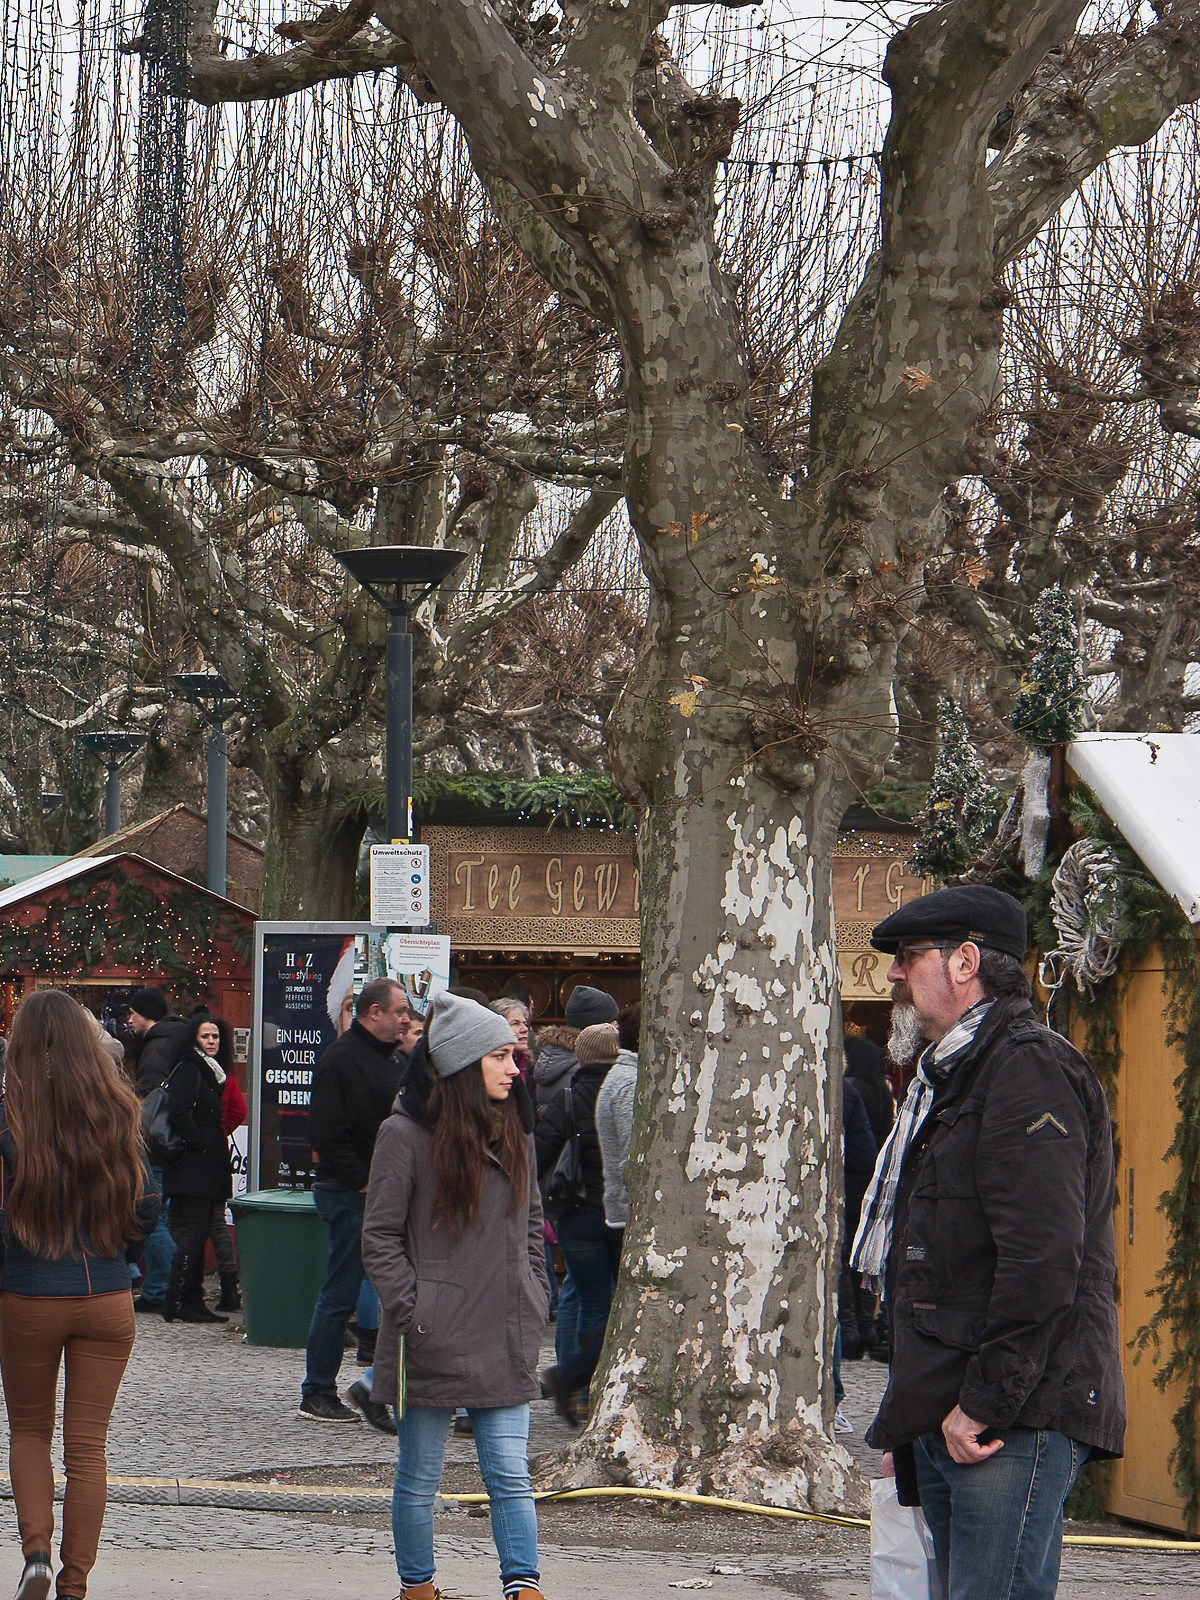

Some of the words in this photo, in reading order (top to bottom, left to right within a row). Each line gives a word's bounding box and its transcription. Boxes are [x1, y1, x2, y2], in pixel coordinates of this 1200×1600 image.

[455, 855, 521, 911] Tee
[276, 1029, 292, 1043] EIN
[294, 1030, 321, 1044] HAUS
[281, 1050, 316, 1064] VOLLER
[278, 1090, 312, 1105] IDEEN
